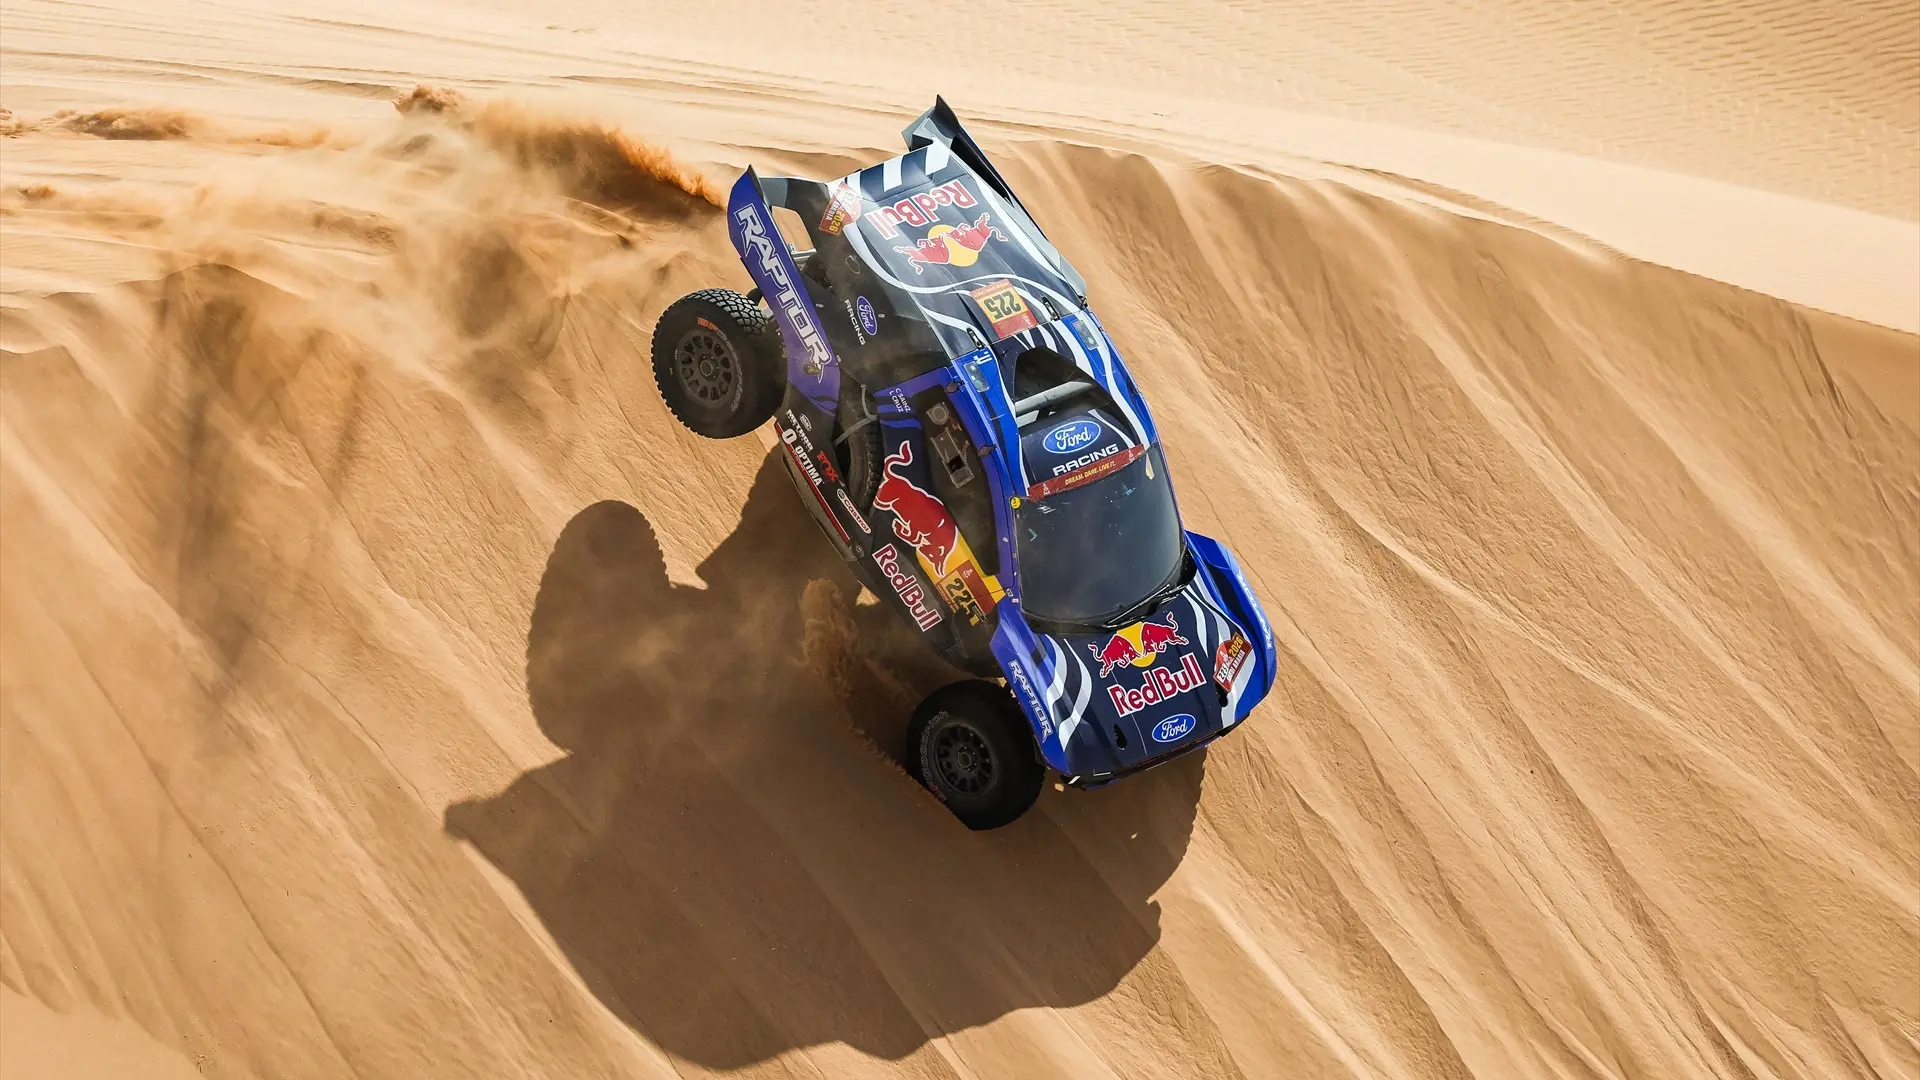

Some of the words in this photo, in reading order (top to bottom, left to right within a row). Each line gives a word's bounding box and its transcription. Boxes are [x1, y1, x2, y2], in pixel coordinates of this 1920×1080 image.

[829, 210, 846, 232] 2026
[734, 203, 832, 383] RAPTOR
[984, 291, 1021, 319] 225
[844, 299, 866, 345] RACING
[858, 303, 874, 329] Ford
[892, 395, 904, 413] CRUZ
[898, 393, 911, 412] SAINZ
[1053, 424, 1093, 451] Ford
[795, 445, 823, 487] OPTIMA
[1052, 443, 1119, 476] RACING
[844, 499, 870, 532] Castrol
[1228, 636, 1244, 657] 2026
[1219, 665, 1228, 680] 225
[1008, 659, 1052, 743] RAPTOR
[1159, 716, 1190, 741] Ford
